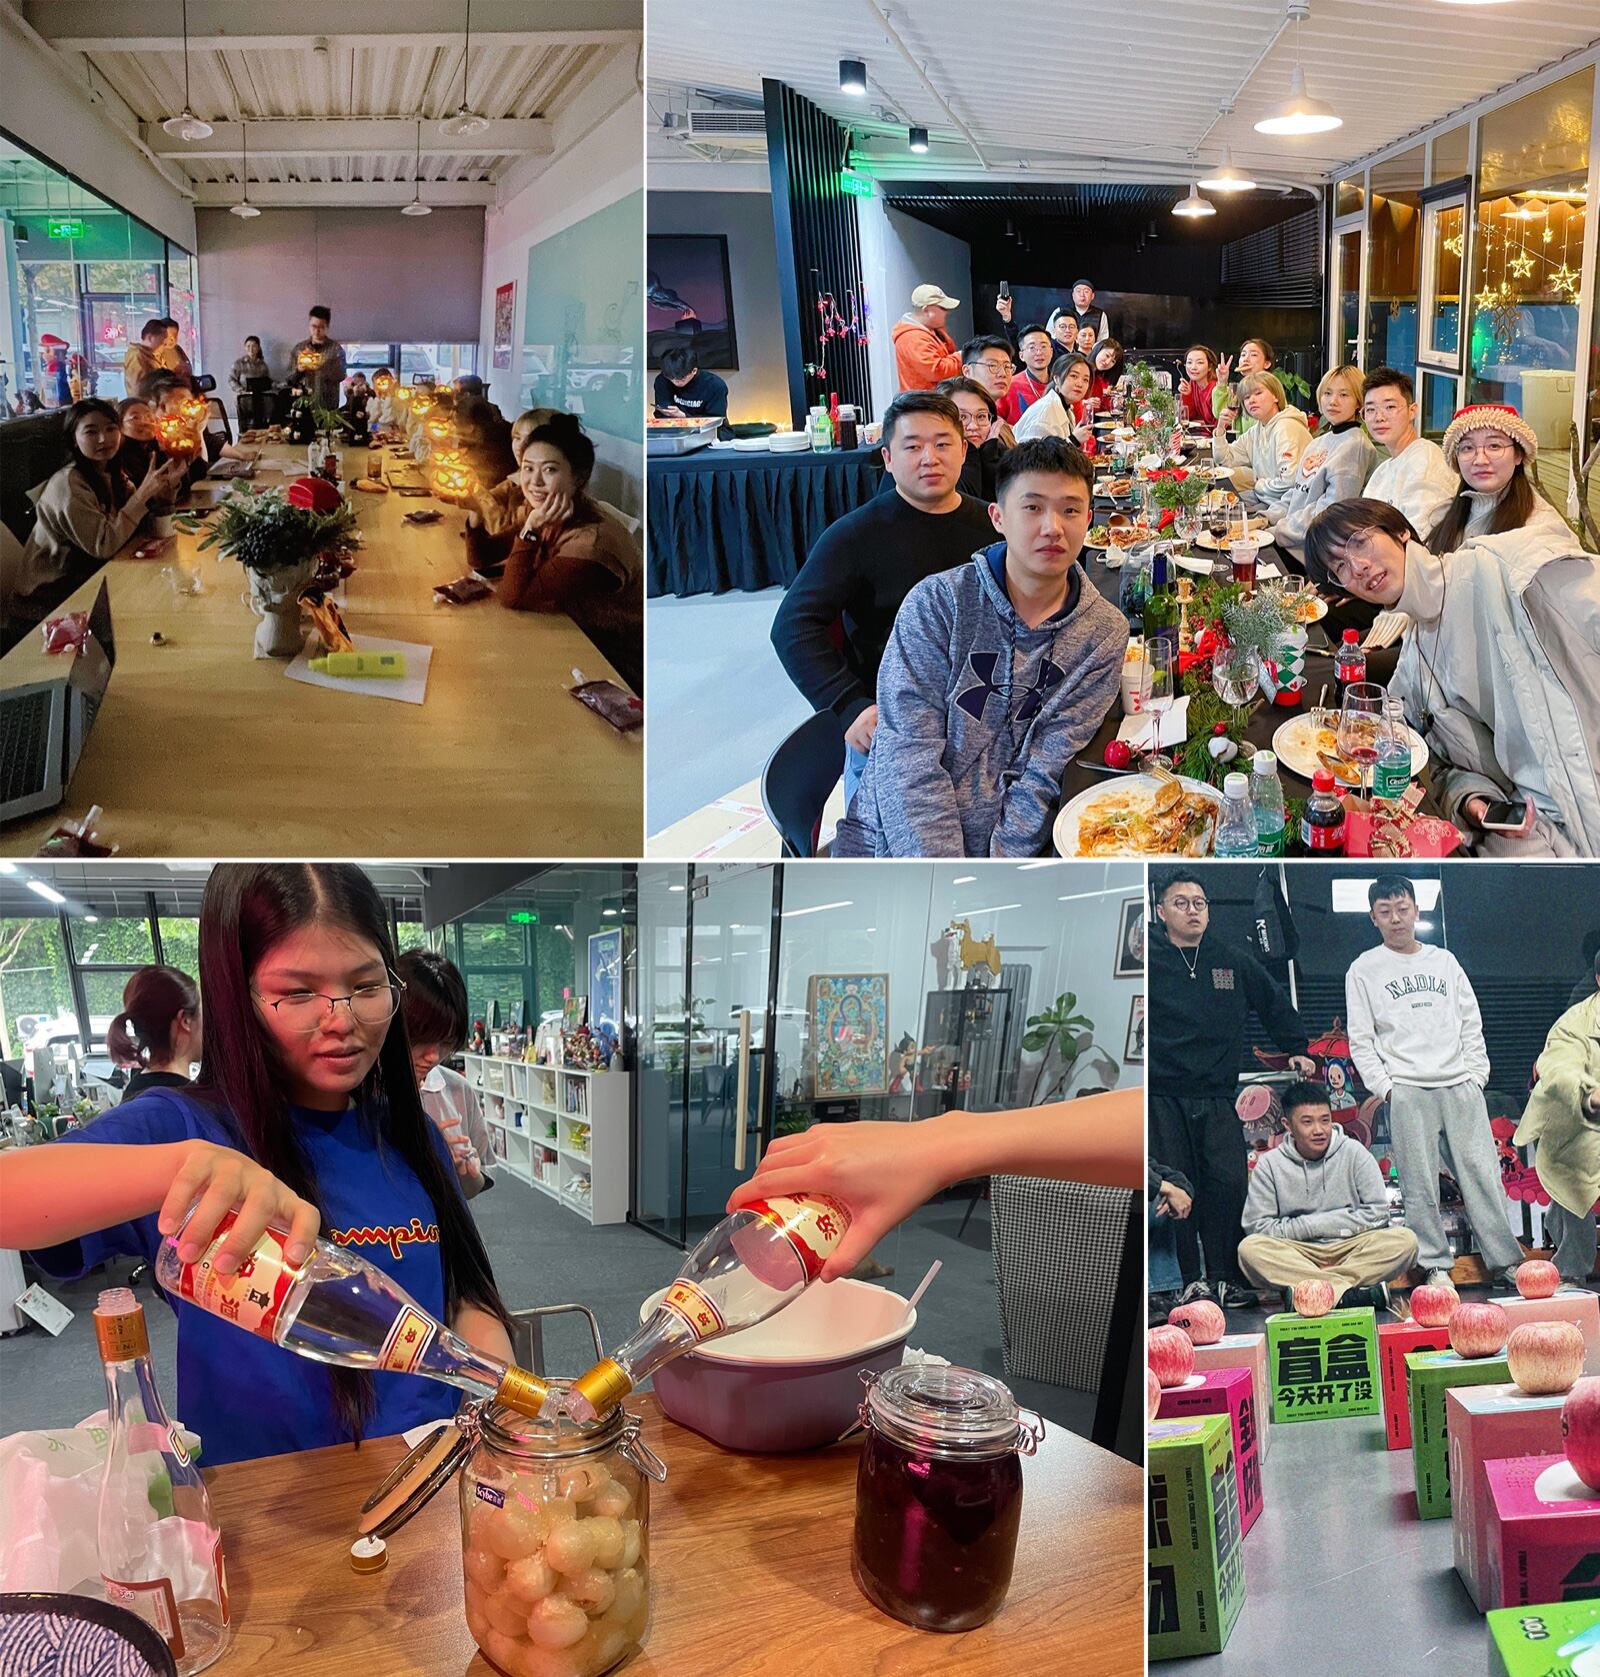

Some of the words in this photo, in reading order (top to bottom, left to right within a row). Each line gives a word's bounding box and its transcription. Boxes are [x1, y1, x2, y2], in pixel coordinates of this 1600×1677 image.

[1385, 973, 1447, 1000] NADIA
[331, 1218, 439, 1259] ampio
[1277, 1334, 1371, 1386] 盲盒
[1277, 1381, 1374, 1408] 今天开了没
[476, 1486, 493, 1501] Scybe
